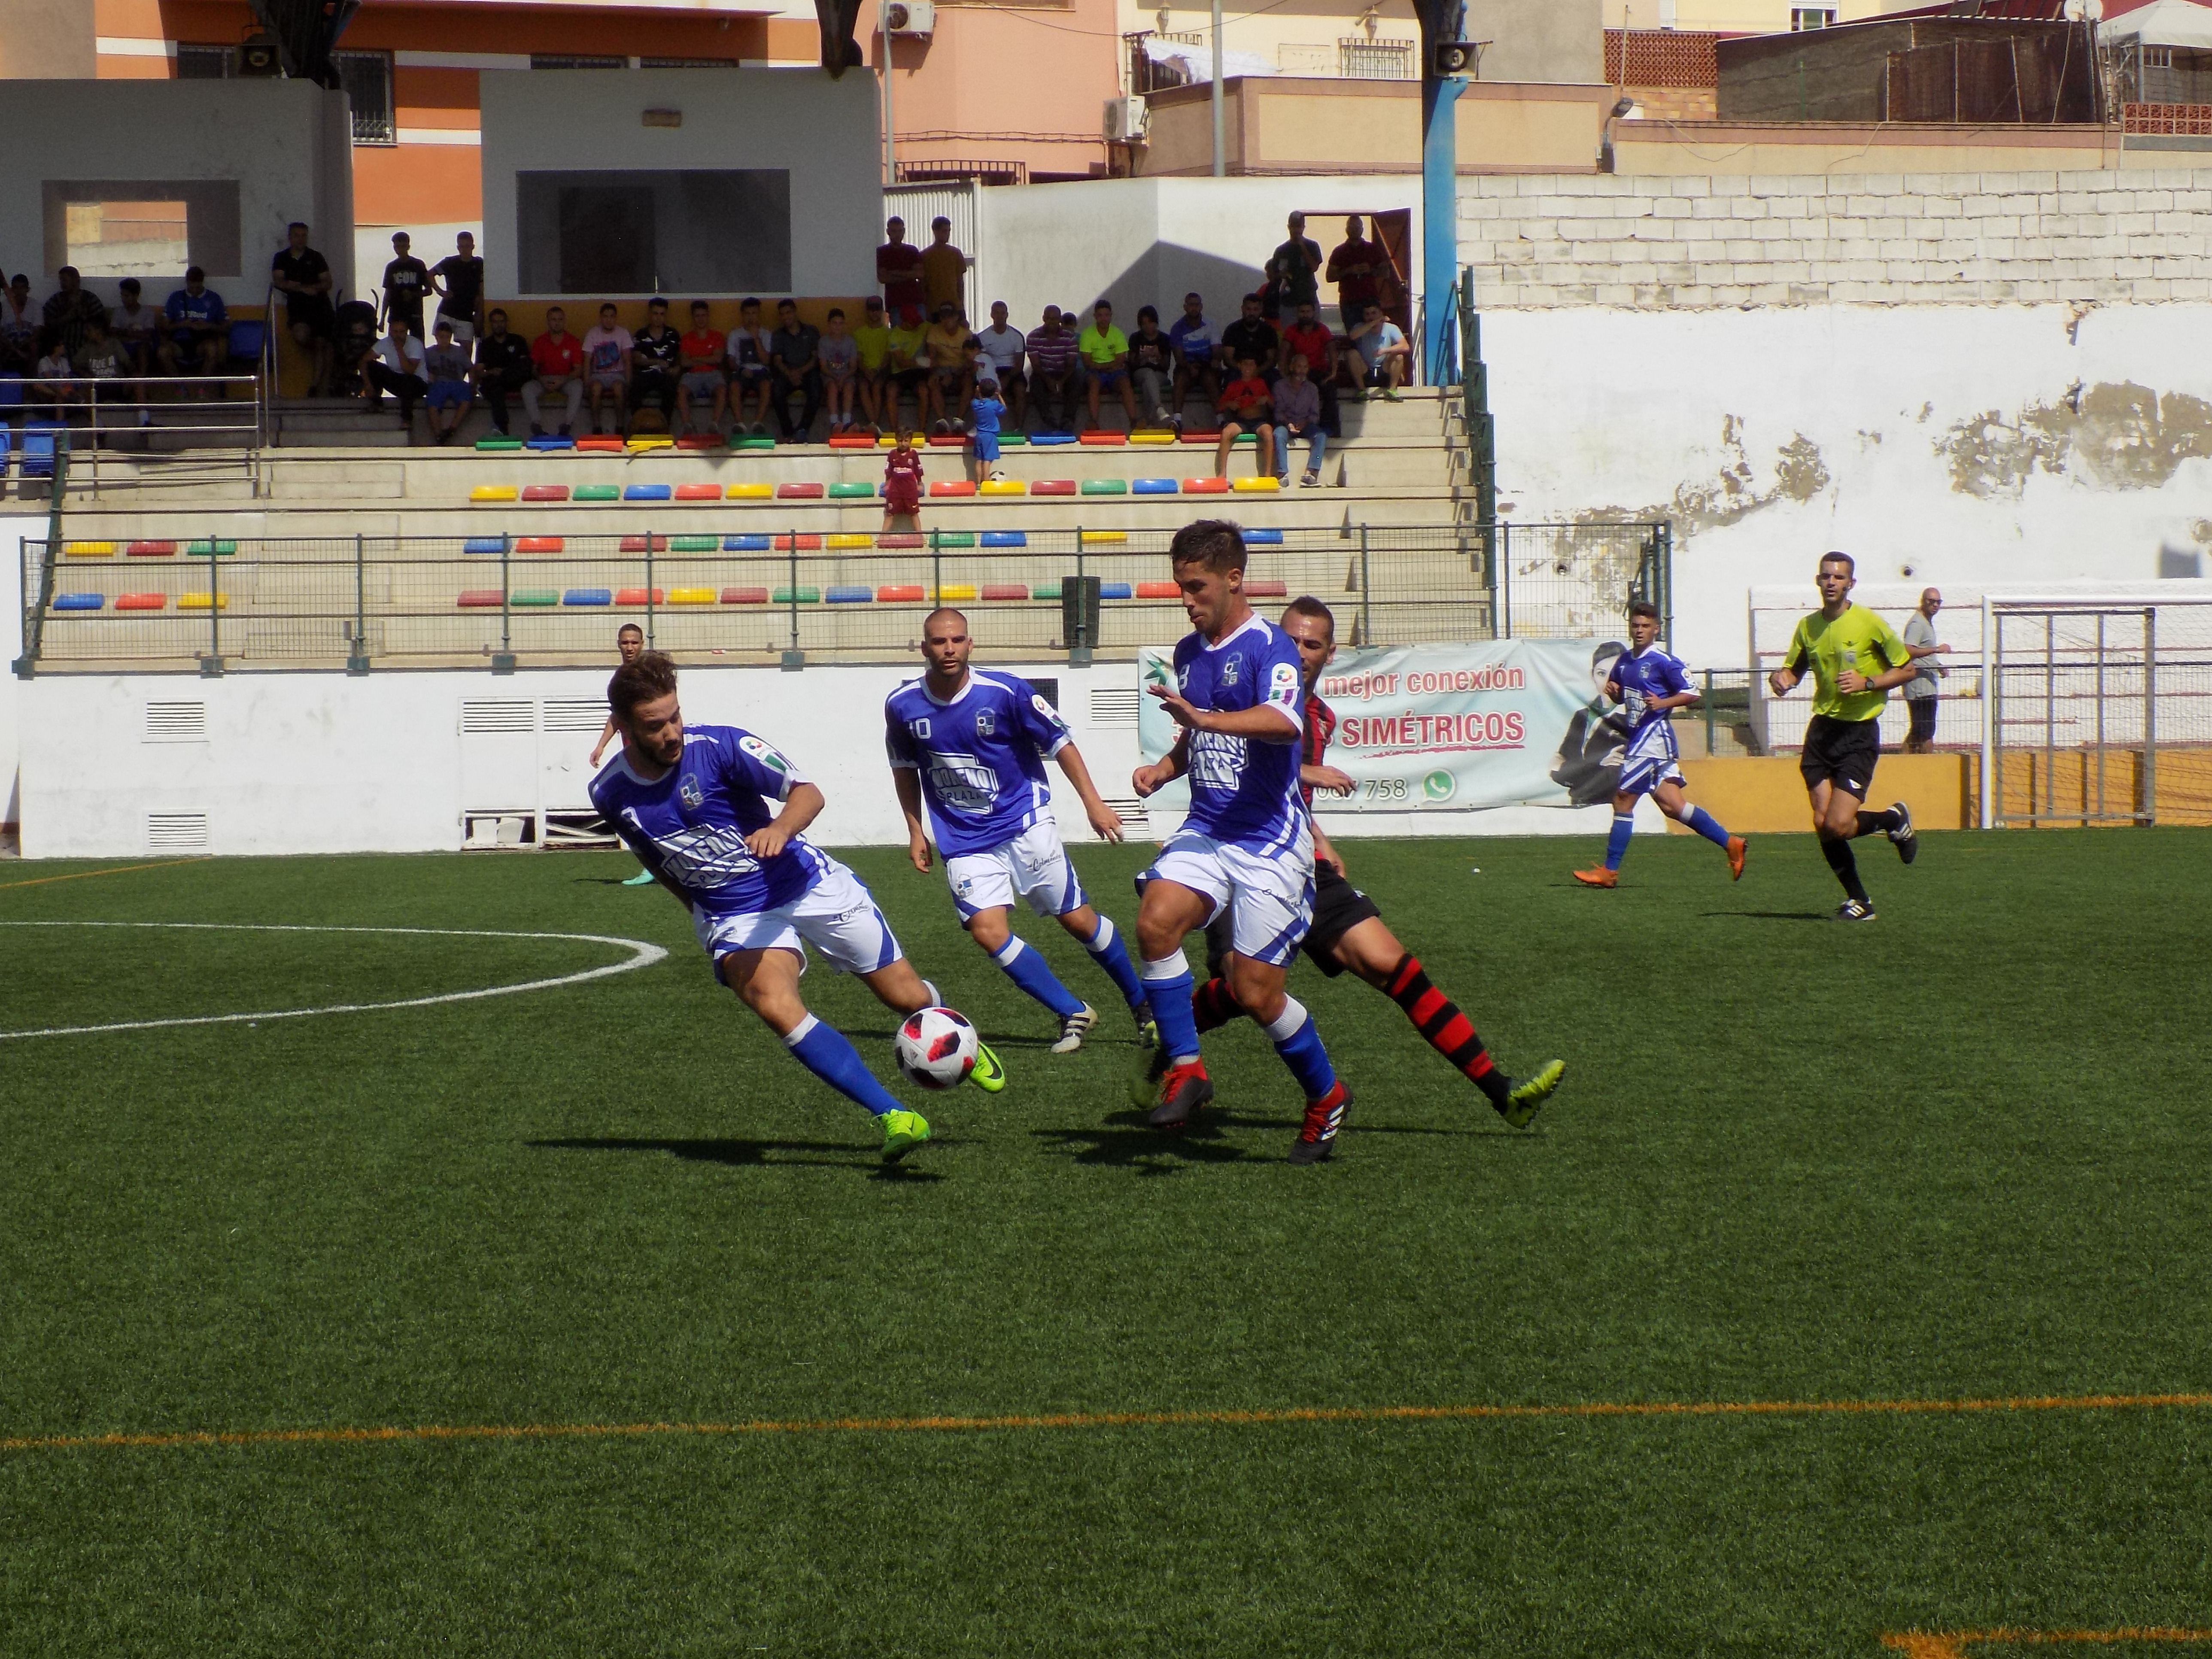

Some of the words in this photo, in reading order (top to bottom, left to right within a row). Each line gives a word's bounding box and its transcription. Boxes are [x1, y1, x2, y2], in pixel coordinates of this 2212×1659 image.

[1178, 664, 1190, 690] 8
[1324, 669, 1400, 701] mejor
[1406, 662, 1524, 694] conexión
[1341, 709, 1525, 748] SIMÉTRICOS
[946, 790, 982, 801] PLAZA
[1365, 778, 1407, 799] 758
